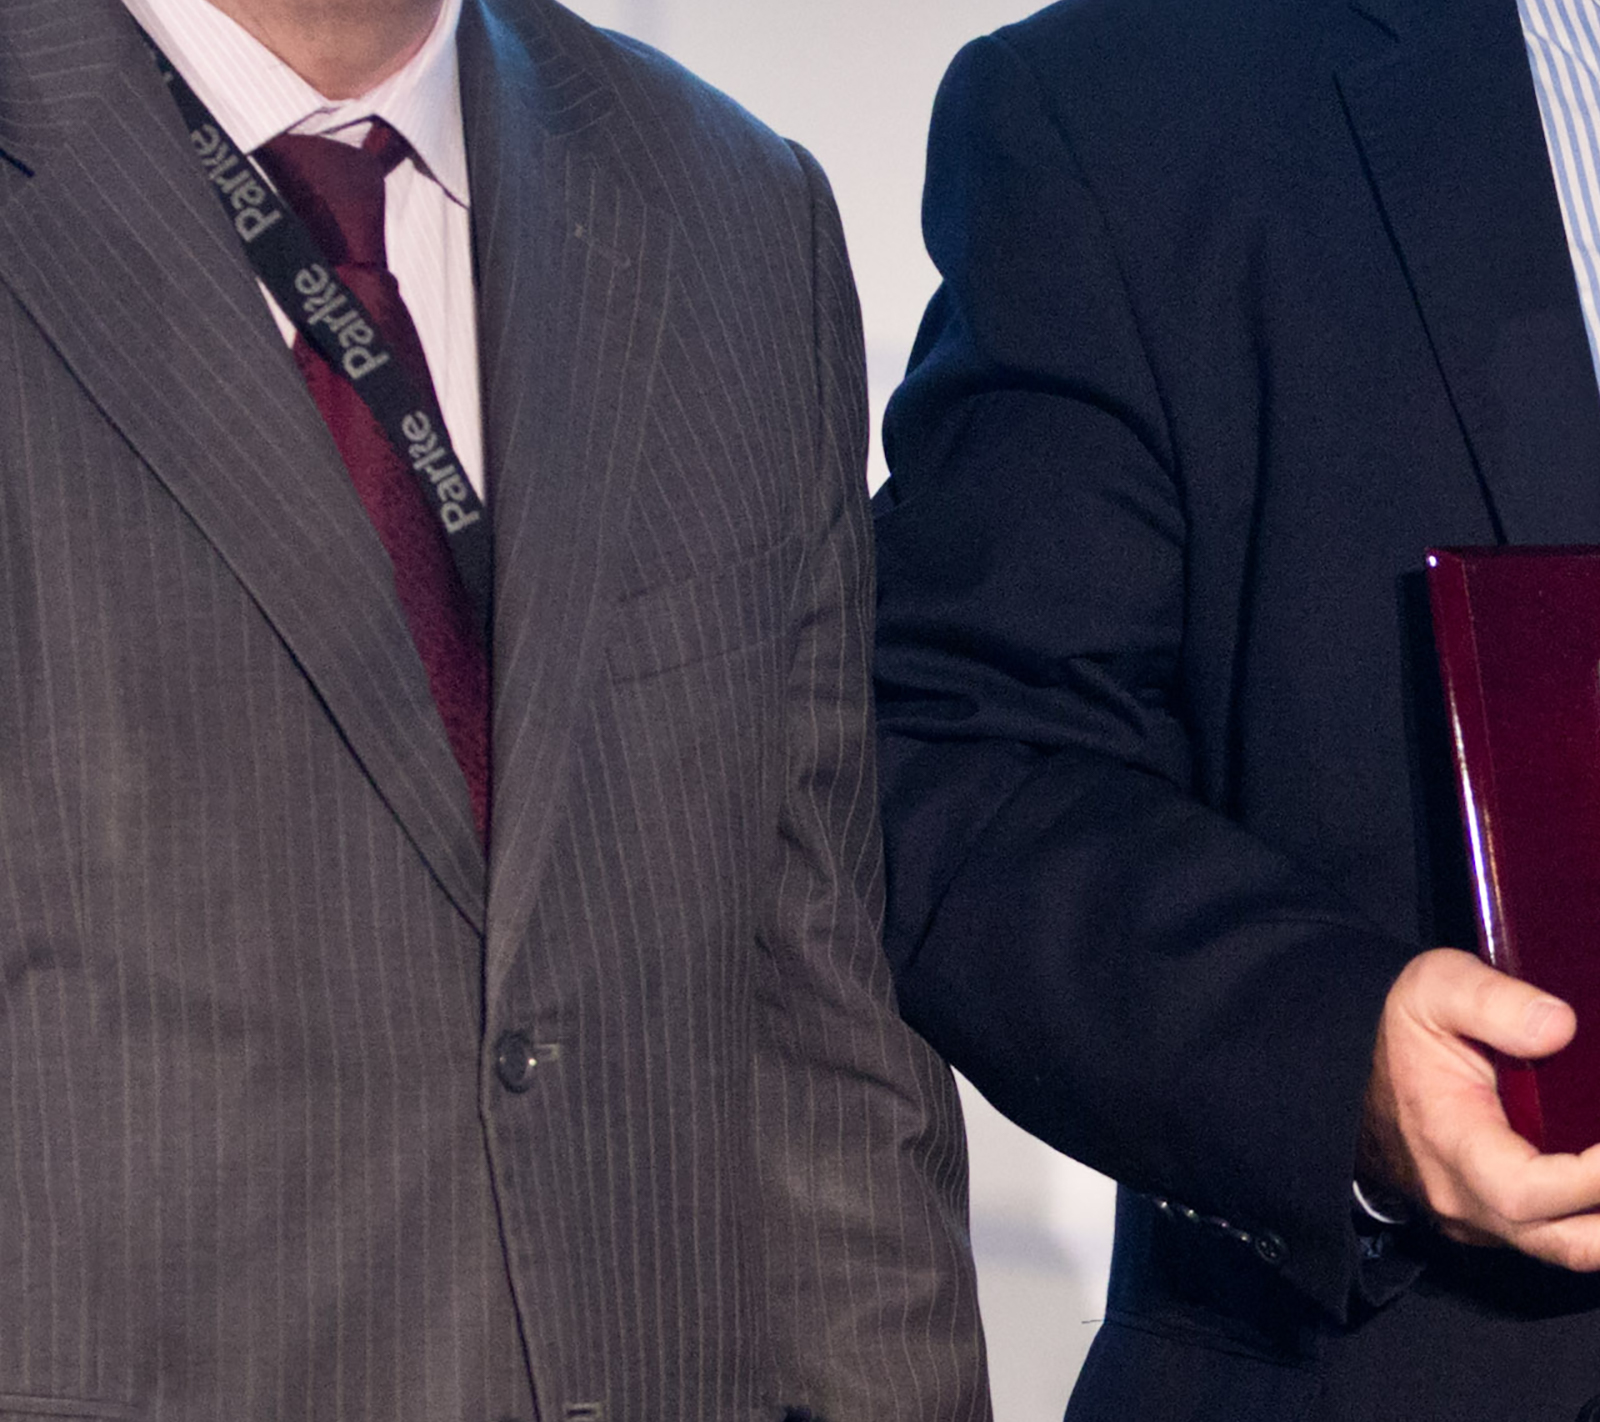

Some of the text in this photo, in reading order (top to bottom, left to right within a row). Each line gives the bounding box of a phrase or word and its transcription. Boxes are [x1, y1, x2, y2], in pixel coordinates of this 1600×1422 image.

[190, 124, 282, 242] Parke
[295, 263, 390, 379] Parke
[402, 411, 480, 532] Parke
